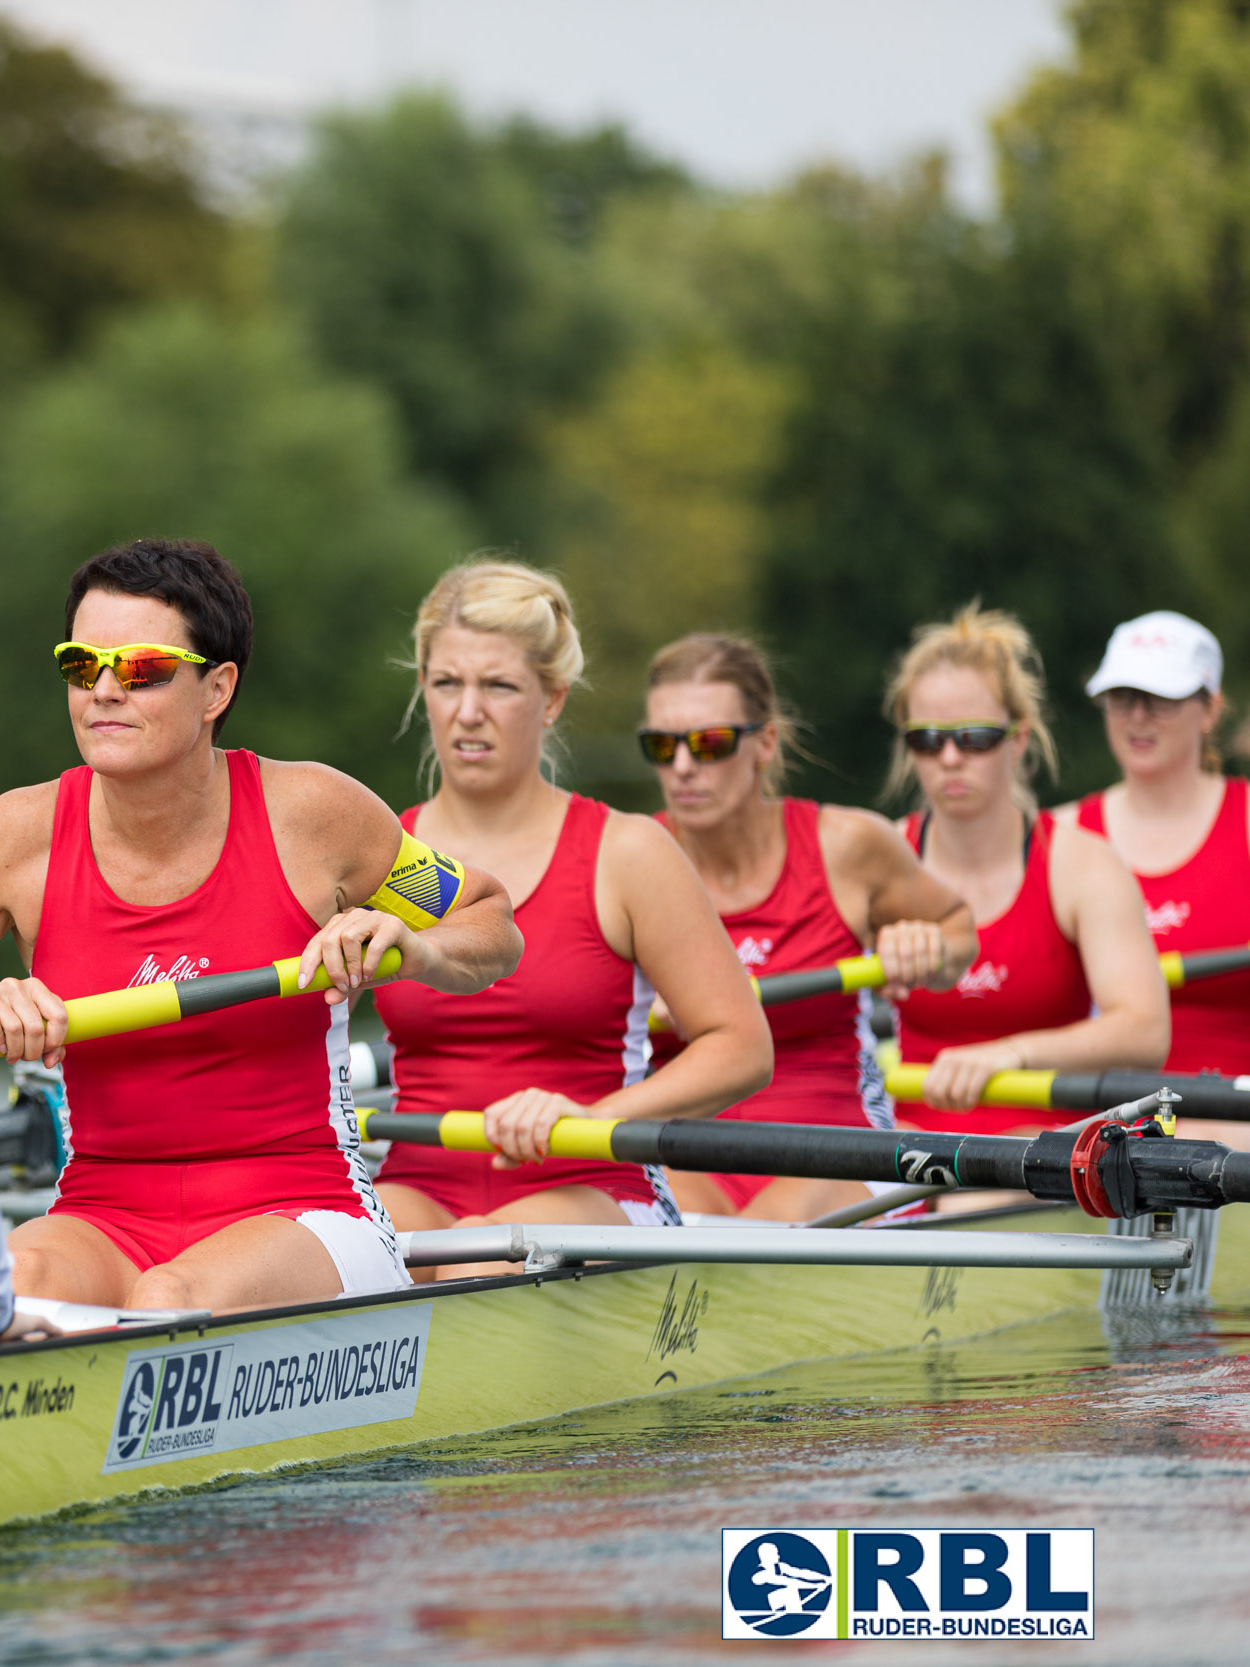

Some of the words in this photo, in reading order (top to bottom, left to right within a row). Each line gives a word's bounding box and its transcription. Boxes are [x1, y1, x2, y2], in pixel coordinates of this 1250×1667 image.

[391, 862, 417, 878] erima
[21, 1377, 75, 1417] Minden
[153, 1350, 222, 1432] RBL
[227, 1336, 419, 1420] RUDER-BUNDESLIGA
[147, 1427, 215, 1453] RUDER-BUNDESLIGA
